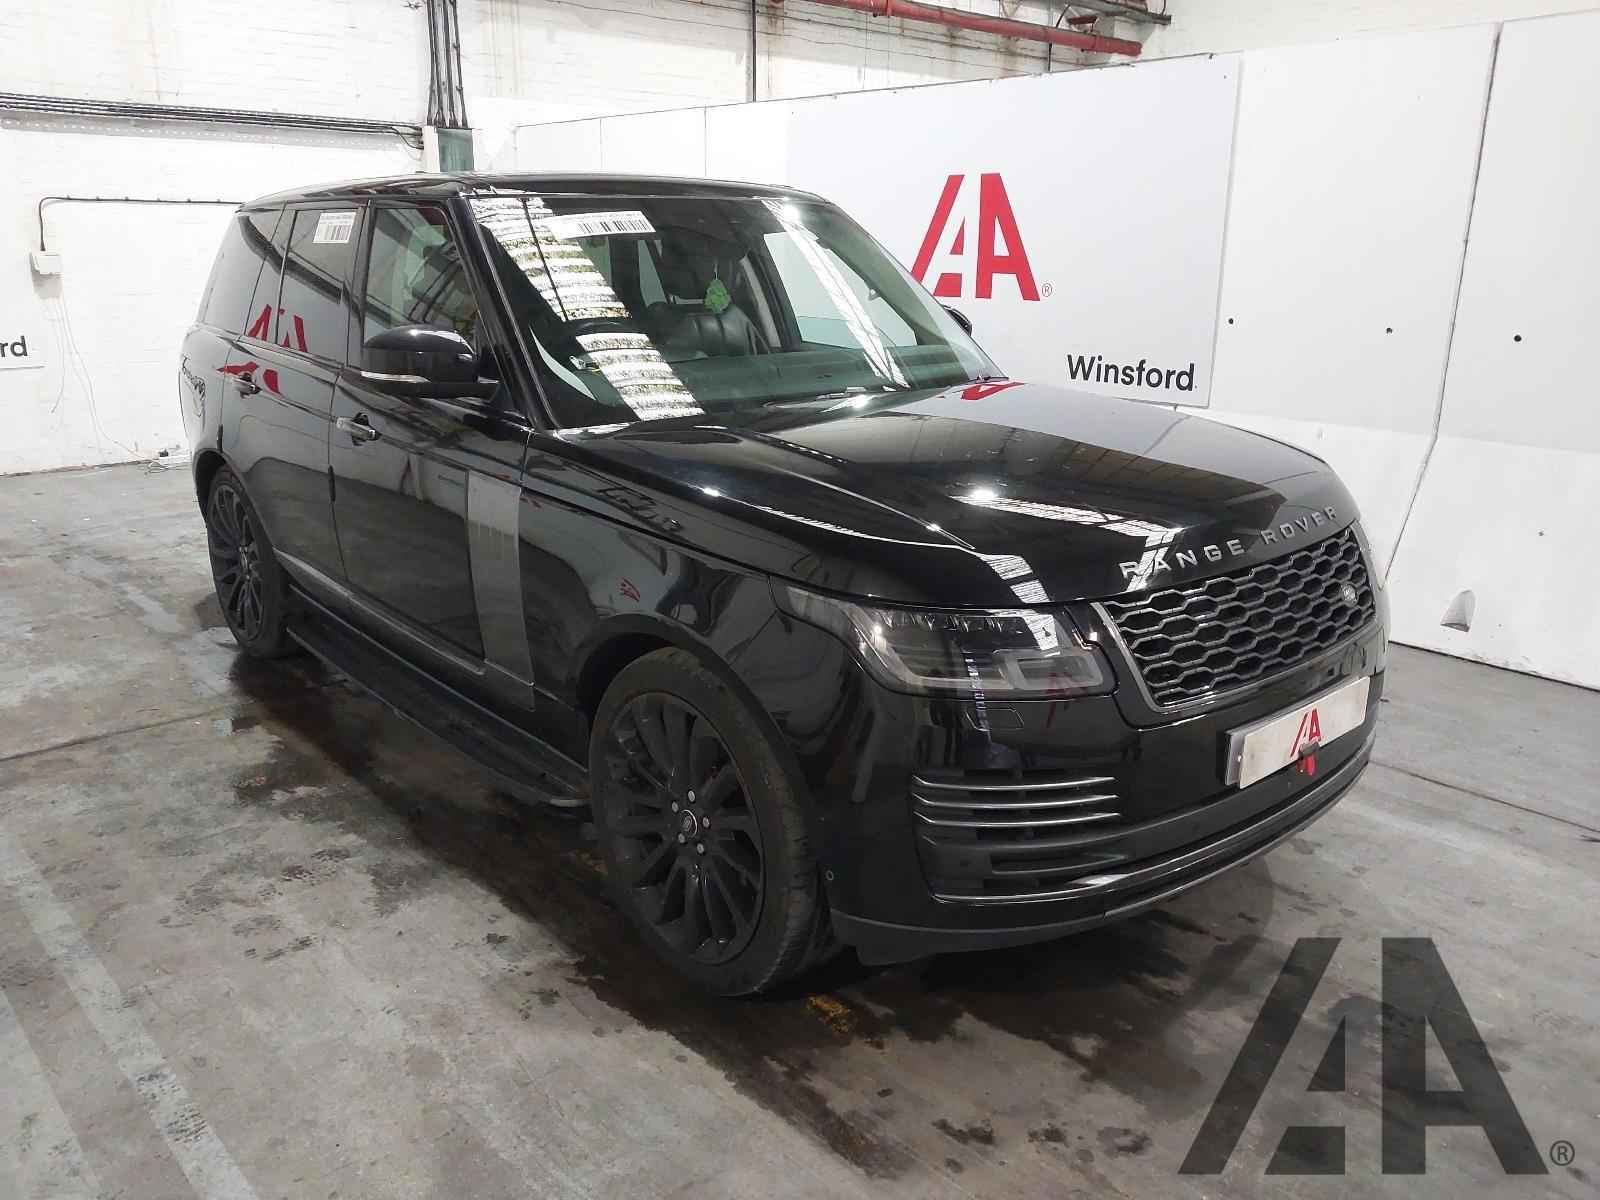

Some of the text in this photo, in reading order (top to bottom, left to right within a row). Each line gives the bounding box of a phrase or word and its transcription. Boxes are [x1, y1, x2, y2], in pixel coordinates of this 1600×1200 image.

[911, 173, 1040, 301] AA
[1067, 354, 1195, 391] Winsford
[1119, 505, 1337, 579] RANGE ROVER
